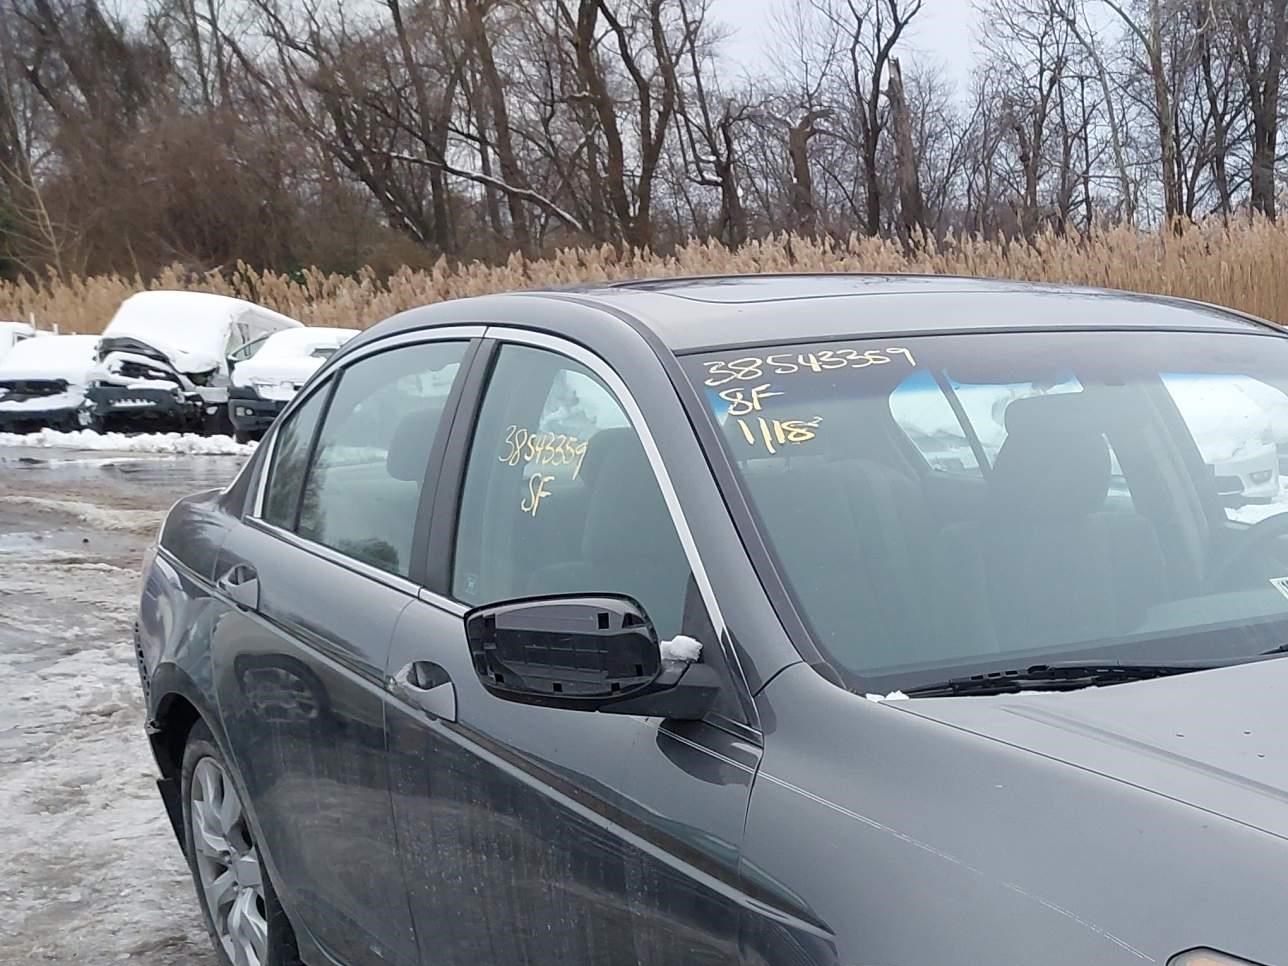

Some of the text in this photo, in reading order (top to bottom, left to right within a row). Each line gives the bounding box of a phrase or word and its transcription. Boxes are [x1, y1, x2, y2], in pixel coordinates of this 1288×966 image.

[703, 347, 917, 386] 38543359
[498, 425, 589, 481] 38543359
[521, 473, 555, 517] SF
